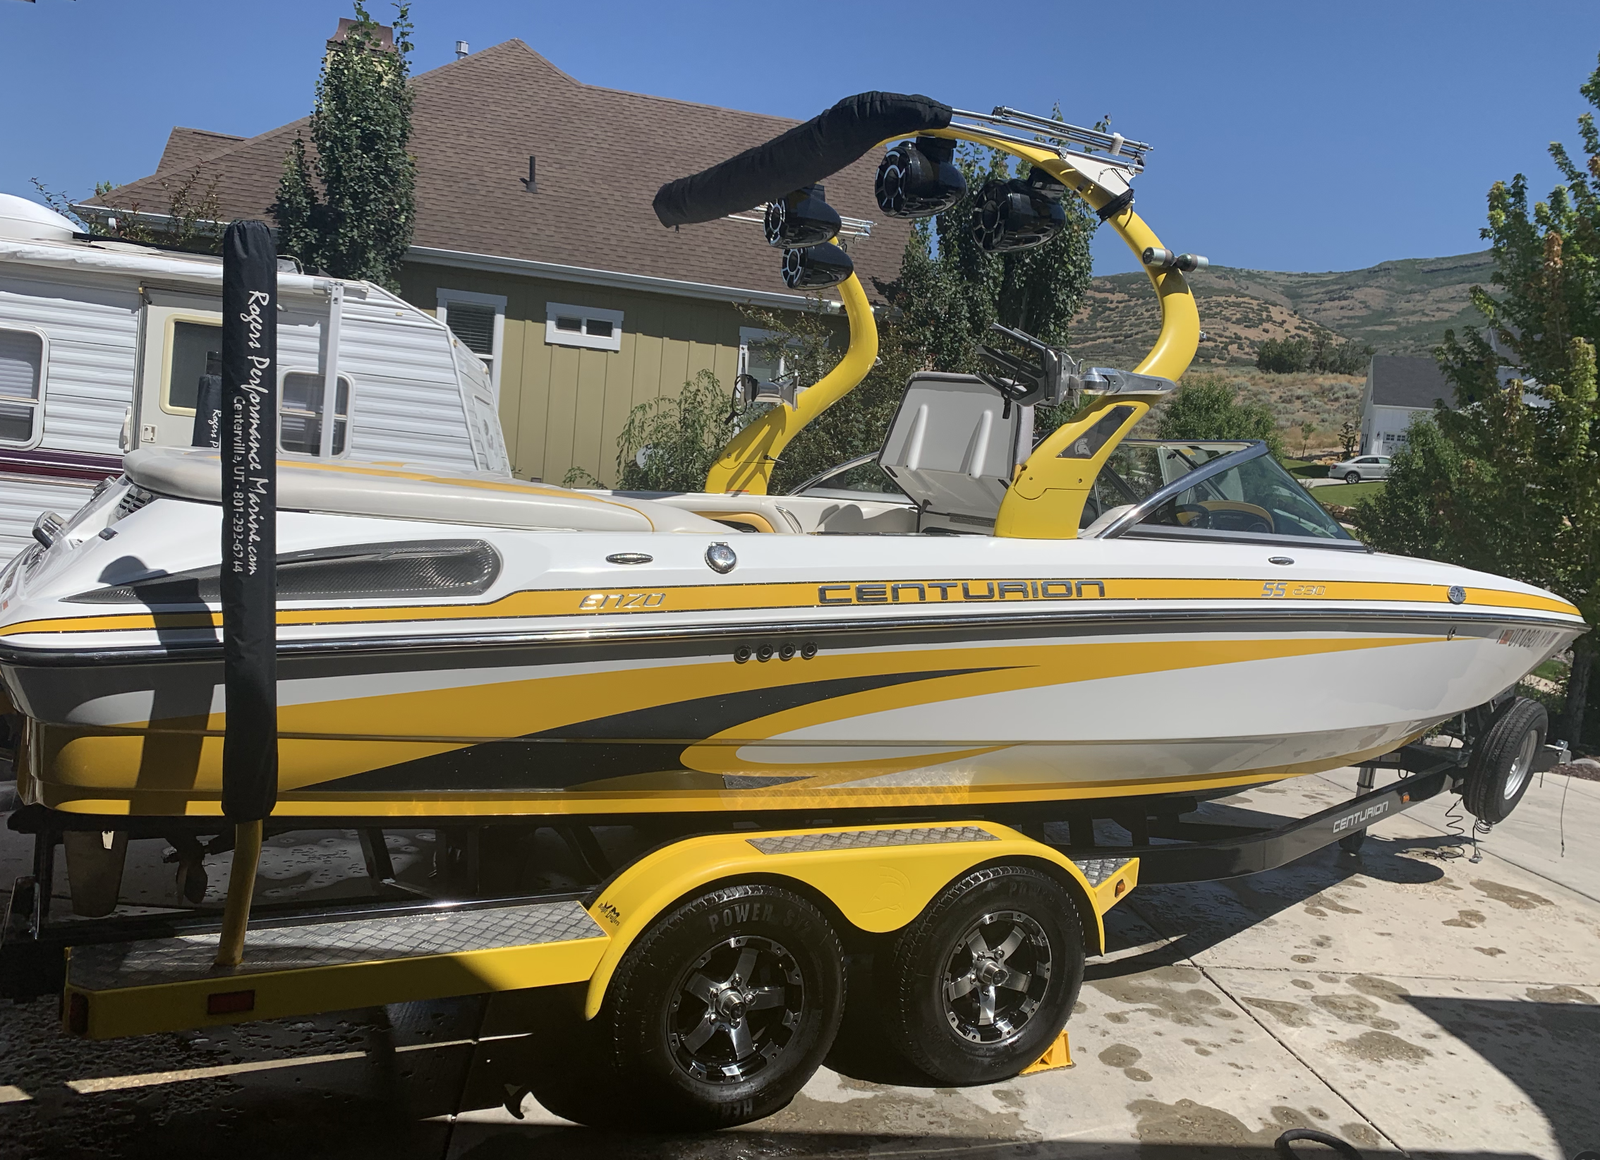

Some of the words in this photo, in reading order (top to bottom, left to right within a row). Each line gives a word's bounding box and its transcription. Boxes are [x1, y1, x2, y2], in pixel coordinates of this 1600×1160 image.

[240, 290, 270, 349] Rogers
[208, 409, 222, 438] Rogers
[240, 355, 271, 471] Performance
[233, 466, 245, 483] UT
[247, 477, 269, 576] Marine.com
[818, 580, 1106, 604] CENTURION
[1292, 585, 1326, 595] 230
[1333, 801, 1388, 833] CENTURION
[708, 903, 774, 933] POWER
